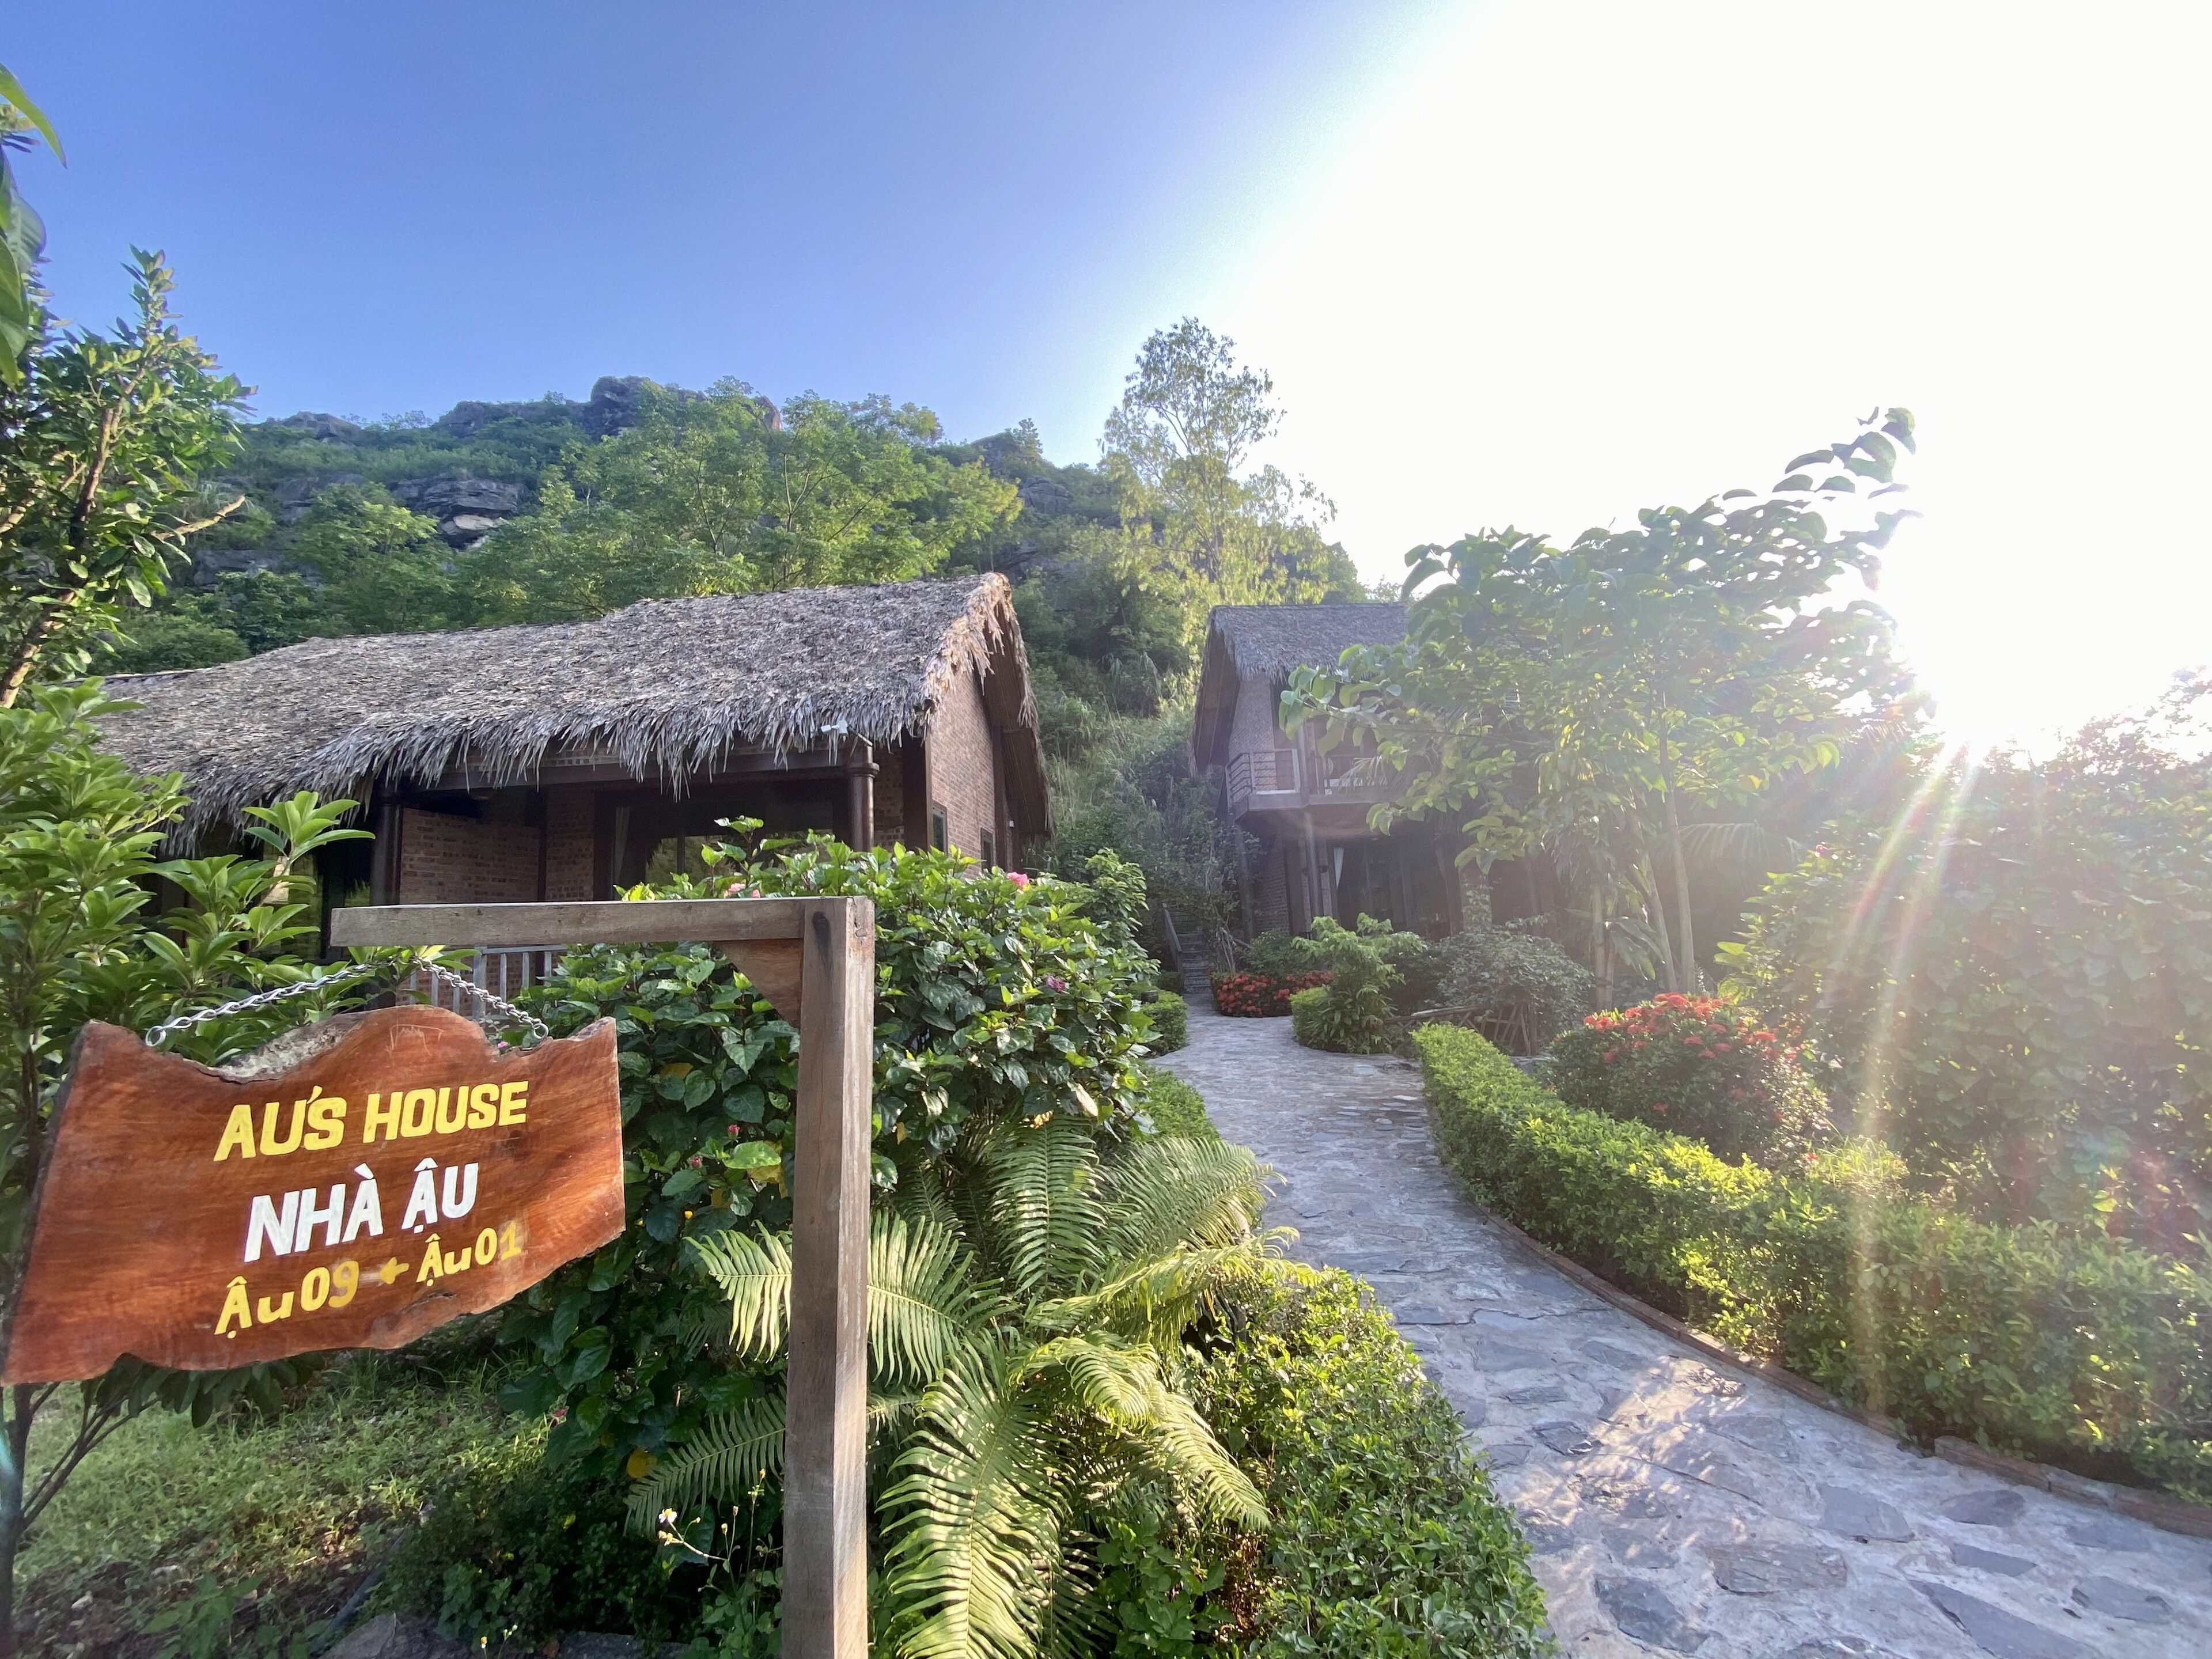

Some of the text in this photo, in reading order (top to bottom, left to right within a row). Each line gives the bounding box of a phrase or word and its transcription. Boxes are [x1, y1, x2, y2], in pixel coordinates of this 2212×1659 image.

[213, 1081, 529, 1161] AU'S HOUSE
[244, 1158, 479, 1262] NHÀ ẬU
